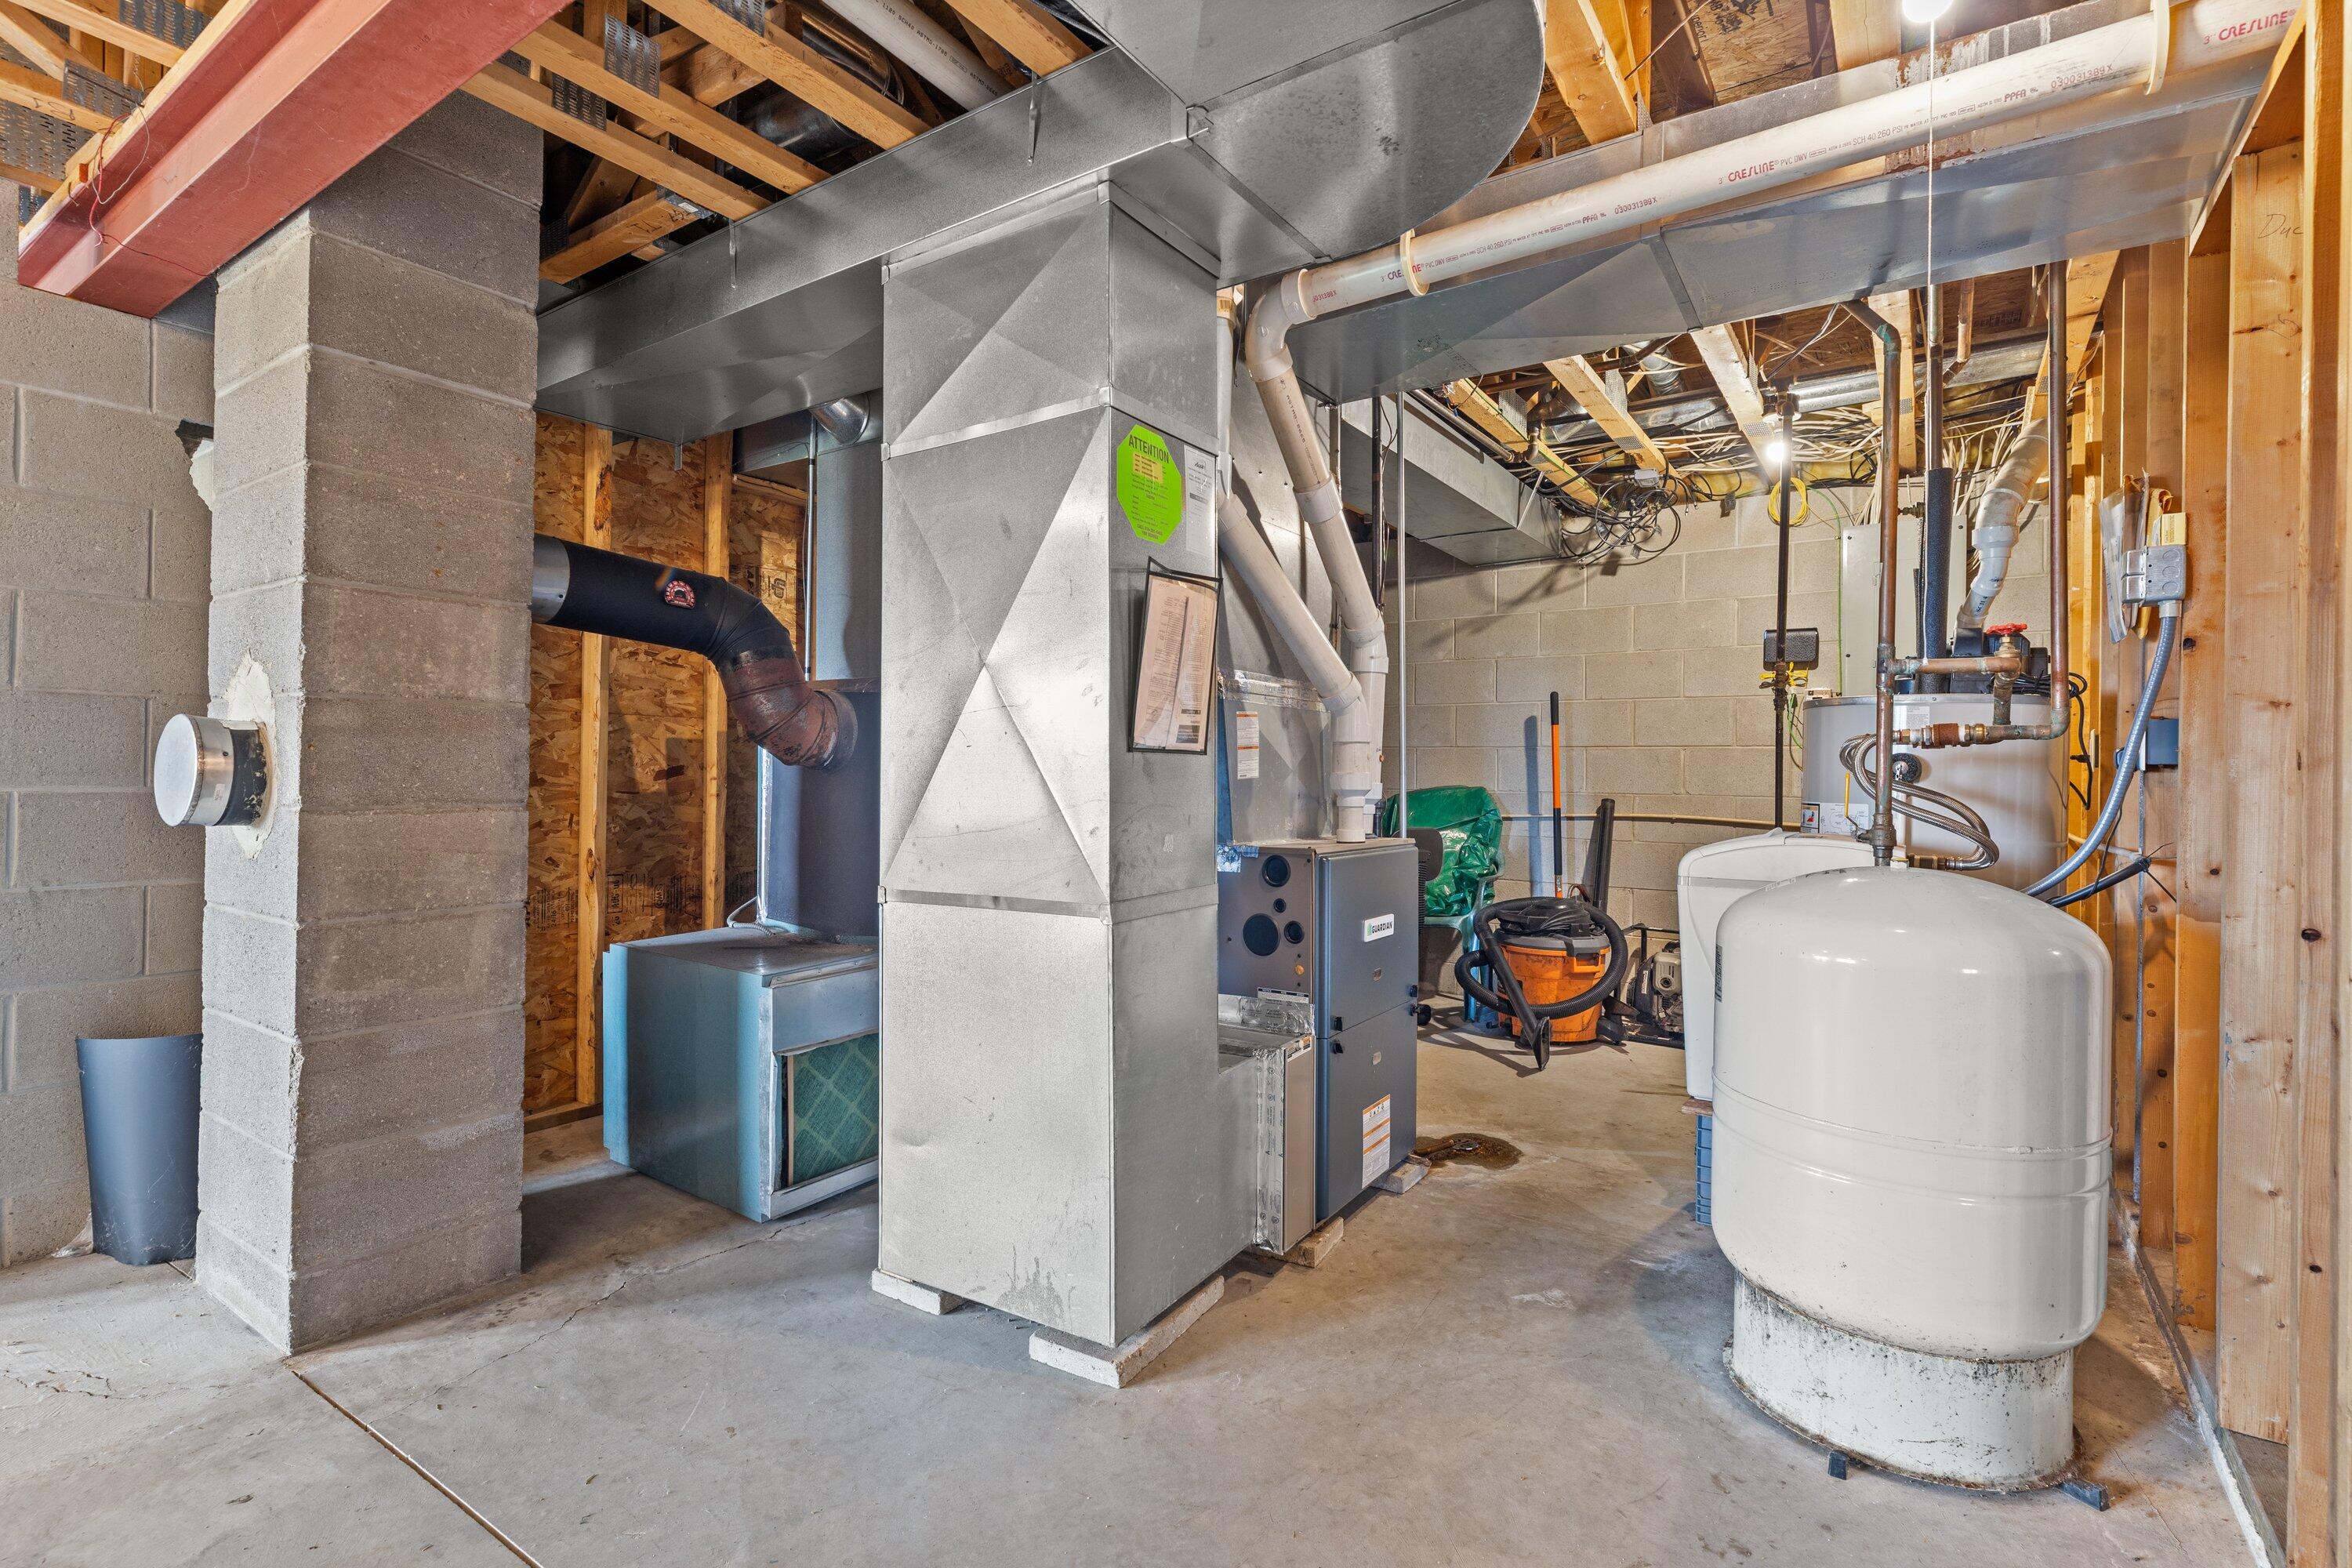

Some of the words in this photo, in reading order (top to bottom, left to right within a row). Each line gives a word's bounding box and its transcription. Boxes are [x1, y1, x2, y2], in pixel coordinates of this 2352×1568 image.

[882, 2, 896, 16] 1120
[898, 15, 915, 31] SCH40
[1780, 156, 1793, 166] PVC
[1794, 152, 1808, 163] DWV
[1853, 135, 1866, 146] SCH
[1867, 132, 1876, 140] 40
[1878, 129, 1891, 139] 260
[1892, 125, 1904, 135] PSI
[2004, 89, 2027, 103] PPFA
[1425, 261, 1435, 270] PVC
[1476, 245, 1486, 255] SCH
[1494, 241, 1504, 249] 260
[1504, 239, 1512, 248] PSI
[1129, 434, 1169, 463] ATTENTION
[1372, 921, 1392, 933] GUARDIAN
